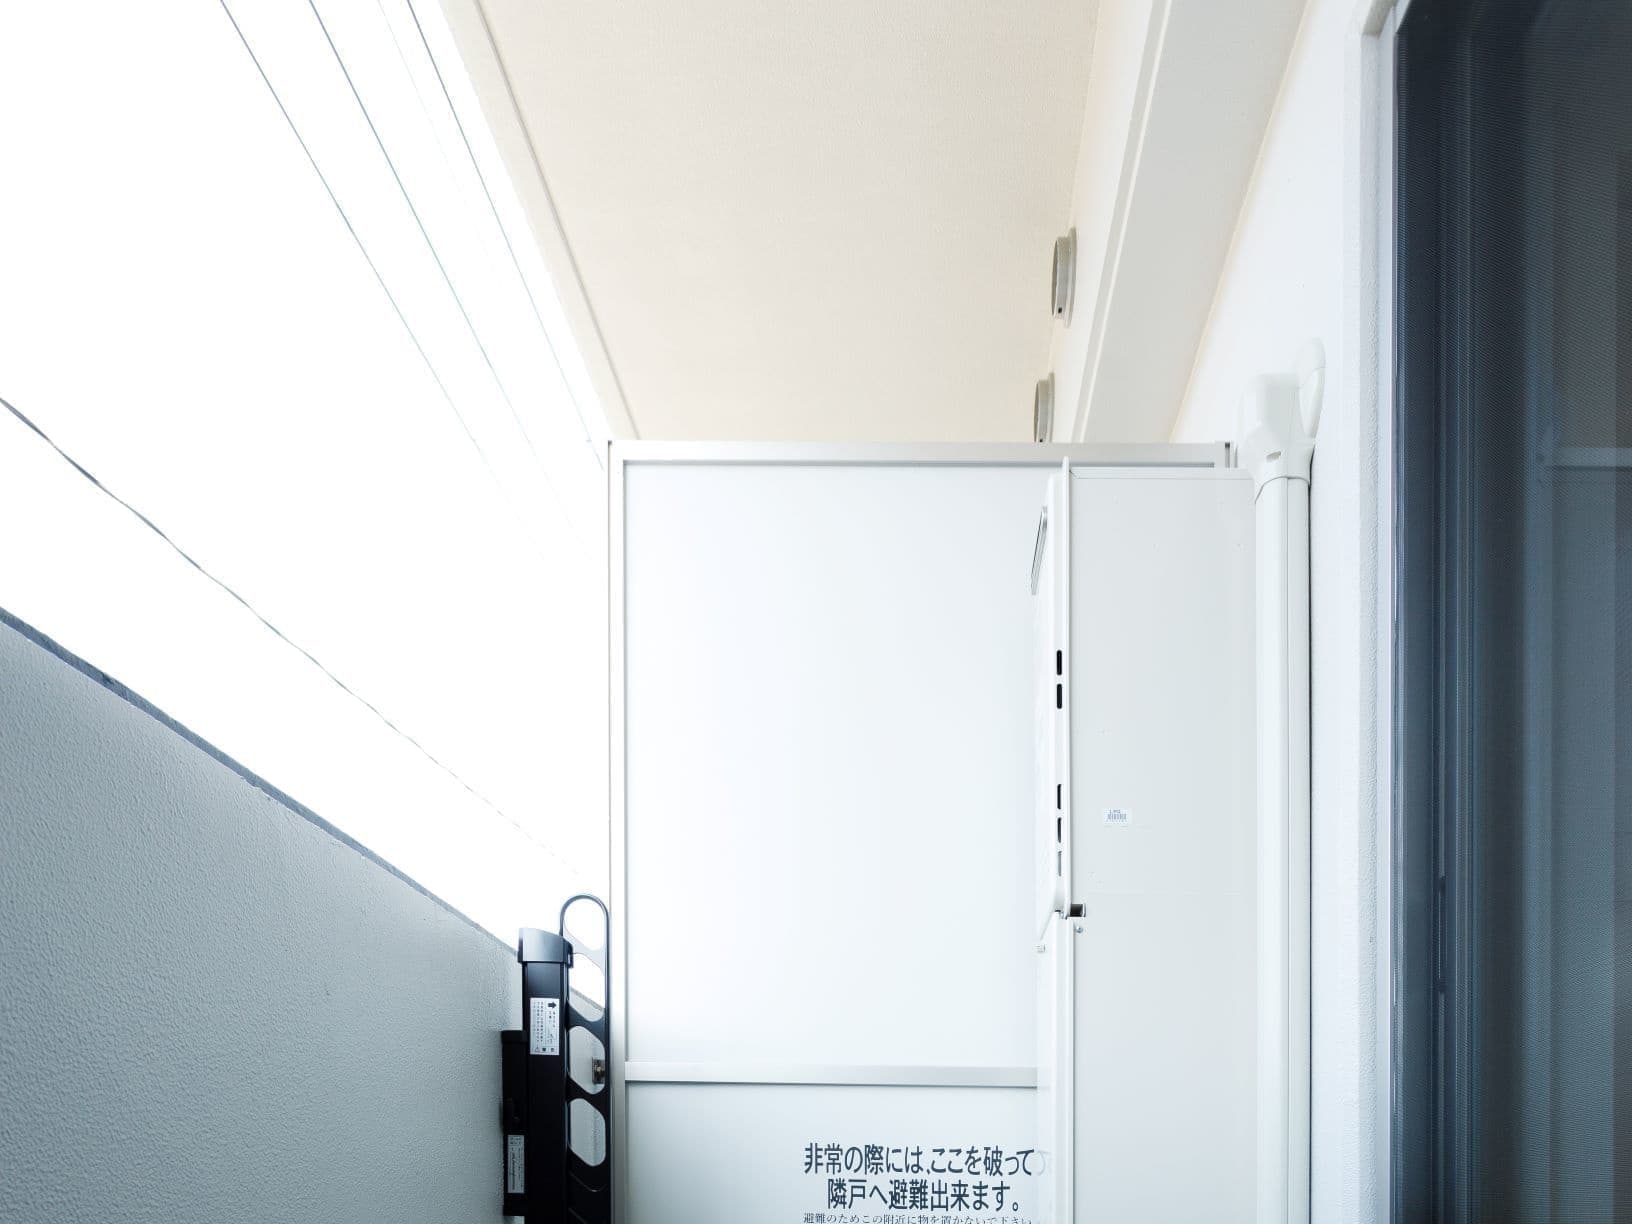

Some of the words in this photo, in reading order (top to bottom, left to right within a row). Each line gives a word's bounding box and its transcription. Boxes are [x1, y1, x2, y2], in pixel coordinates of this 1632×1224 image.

[804, 1143, 1035, 1176] 非常の際には、ここを破って
[827, 1178, 1020, 1212] 隣戸へ避難出来ます。
